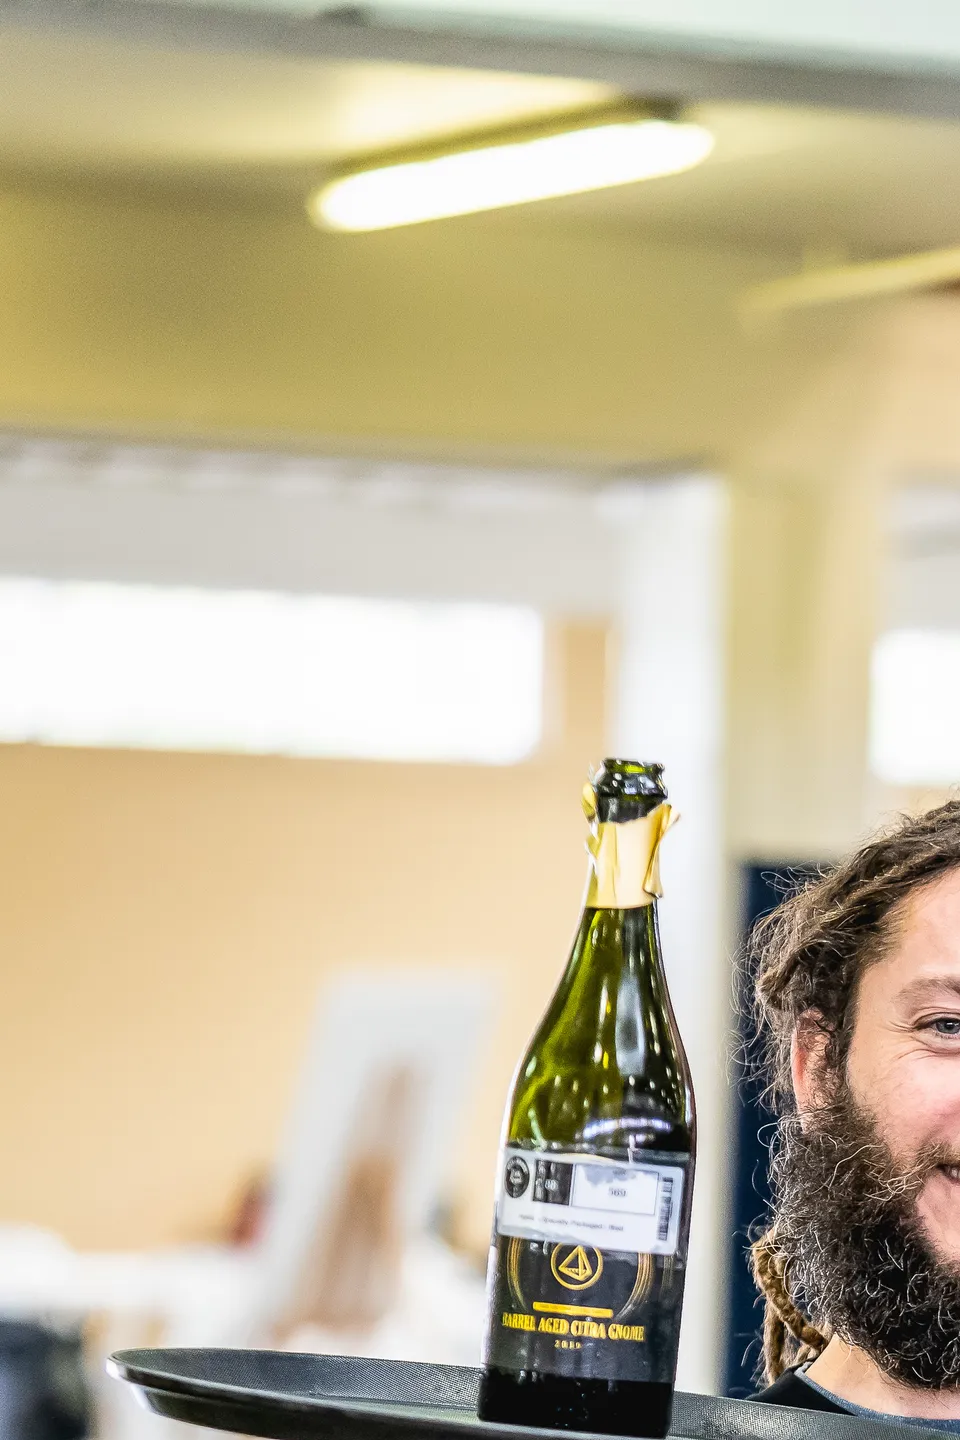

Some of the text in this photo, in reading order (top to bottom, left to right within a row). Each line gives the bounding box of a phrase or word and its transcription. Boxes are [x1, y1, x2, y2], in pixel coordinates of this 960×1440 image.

[502, 1312, 645, 1342] BARREL AGED CITRA GNOME
